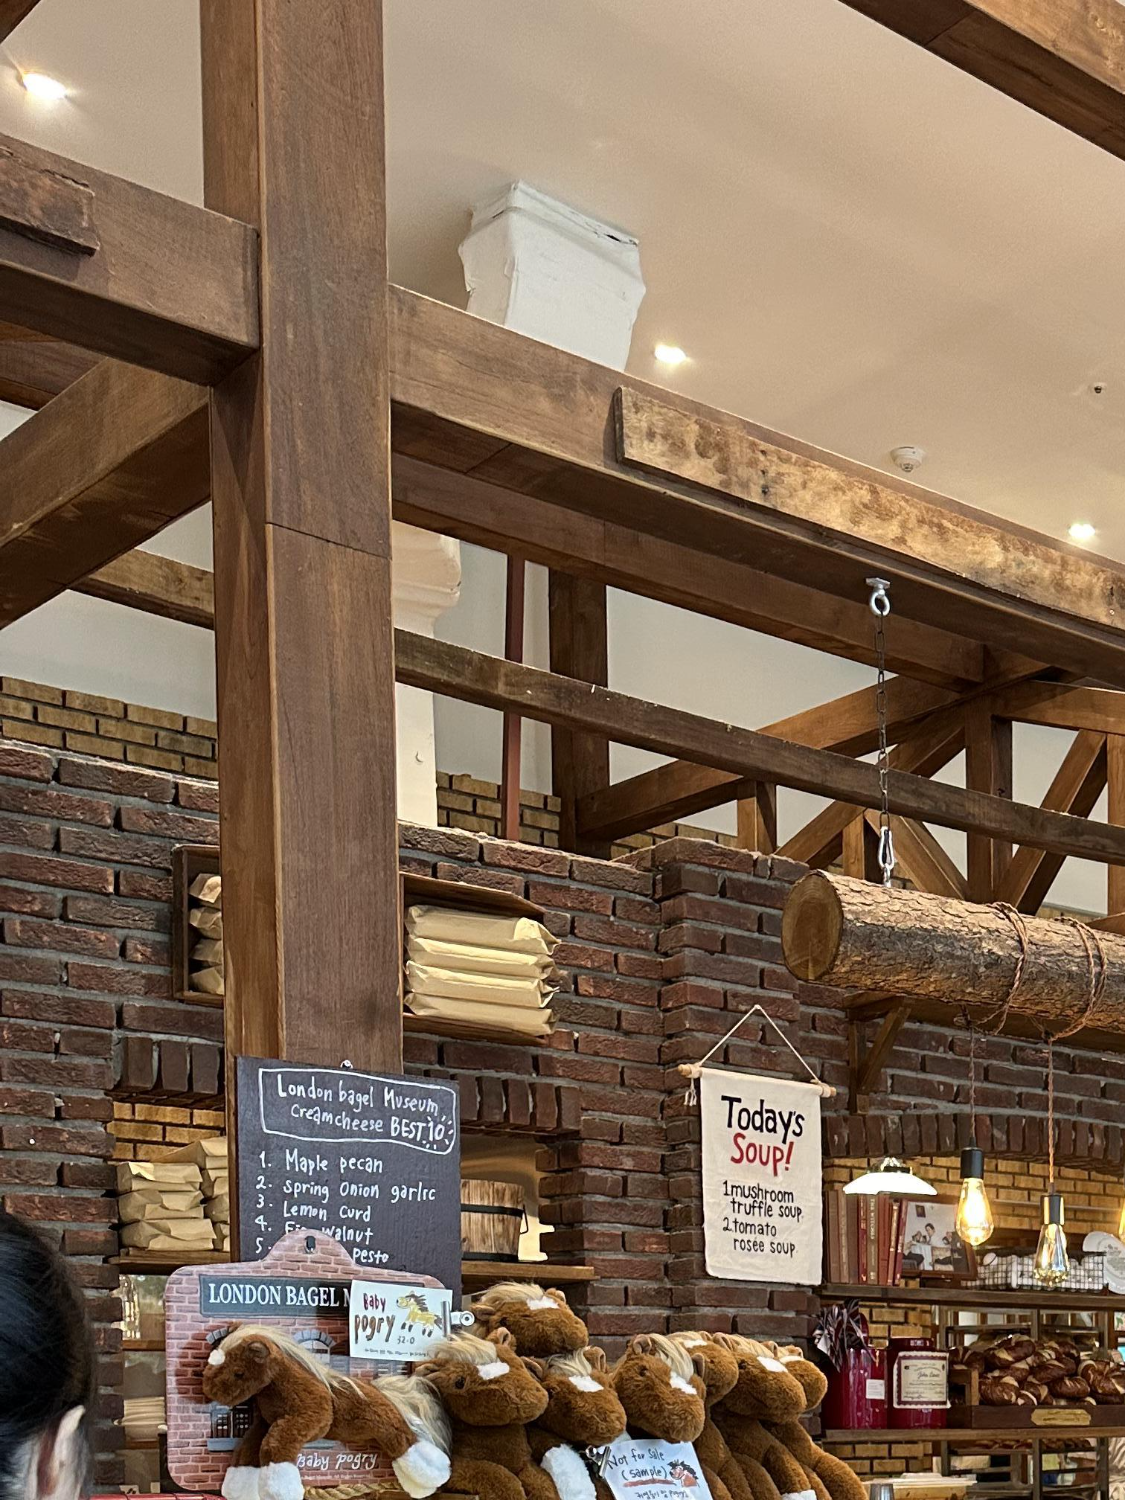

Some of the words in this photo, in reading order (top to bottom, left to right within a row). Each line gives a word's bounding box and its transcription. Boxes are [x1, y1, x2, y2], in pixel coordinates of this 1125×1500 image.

[277, 1074, 333, 1101] London
[339, 1080, 374, 1112] bagel
[384, 1087, 438, 1115] Museum
[721, 1095, 805, 1144] Today's
[285, 1149, 328, 1175] Maple
[340, 1157, 383, 1173] pecan
[731, 1132, 795, 1177] Soup!
[391, 1182, 436, 1203] garlic
[283, 1201, 327, 1221] Lemon
[731, 1198, 773, 1218] truffle
[208, 1283, 282, 1305] LONDON
[286, 1286, 340, 1307] BAGEL
[363, 1293, 386, 1313] Baby
[607, 1455, 628, 1469] Not
[631, 1449, 645, 1461] for
